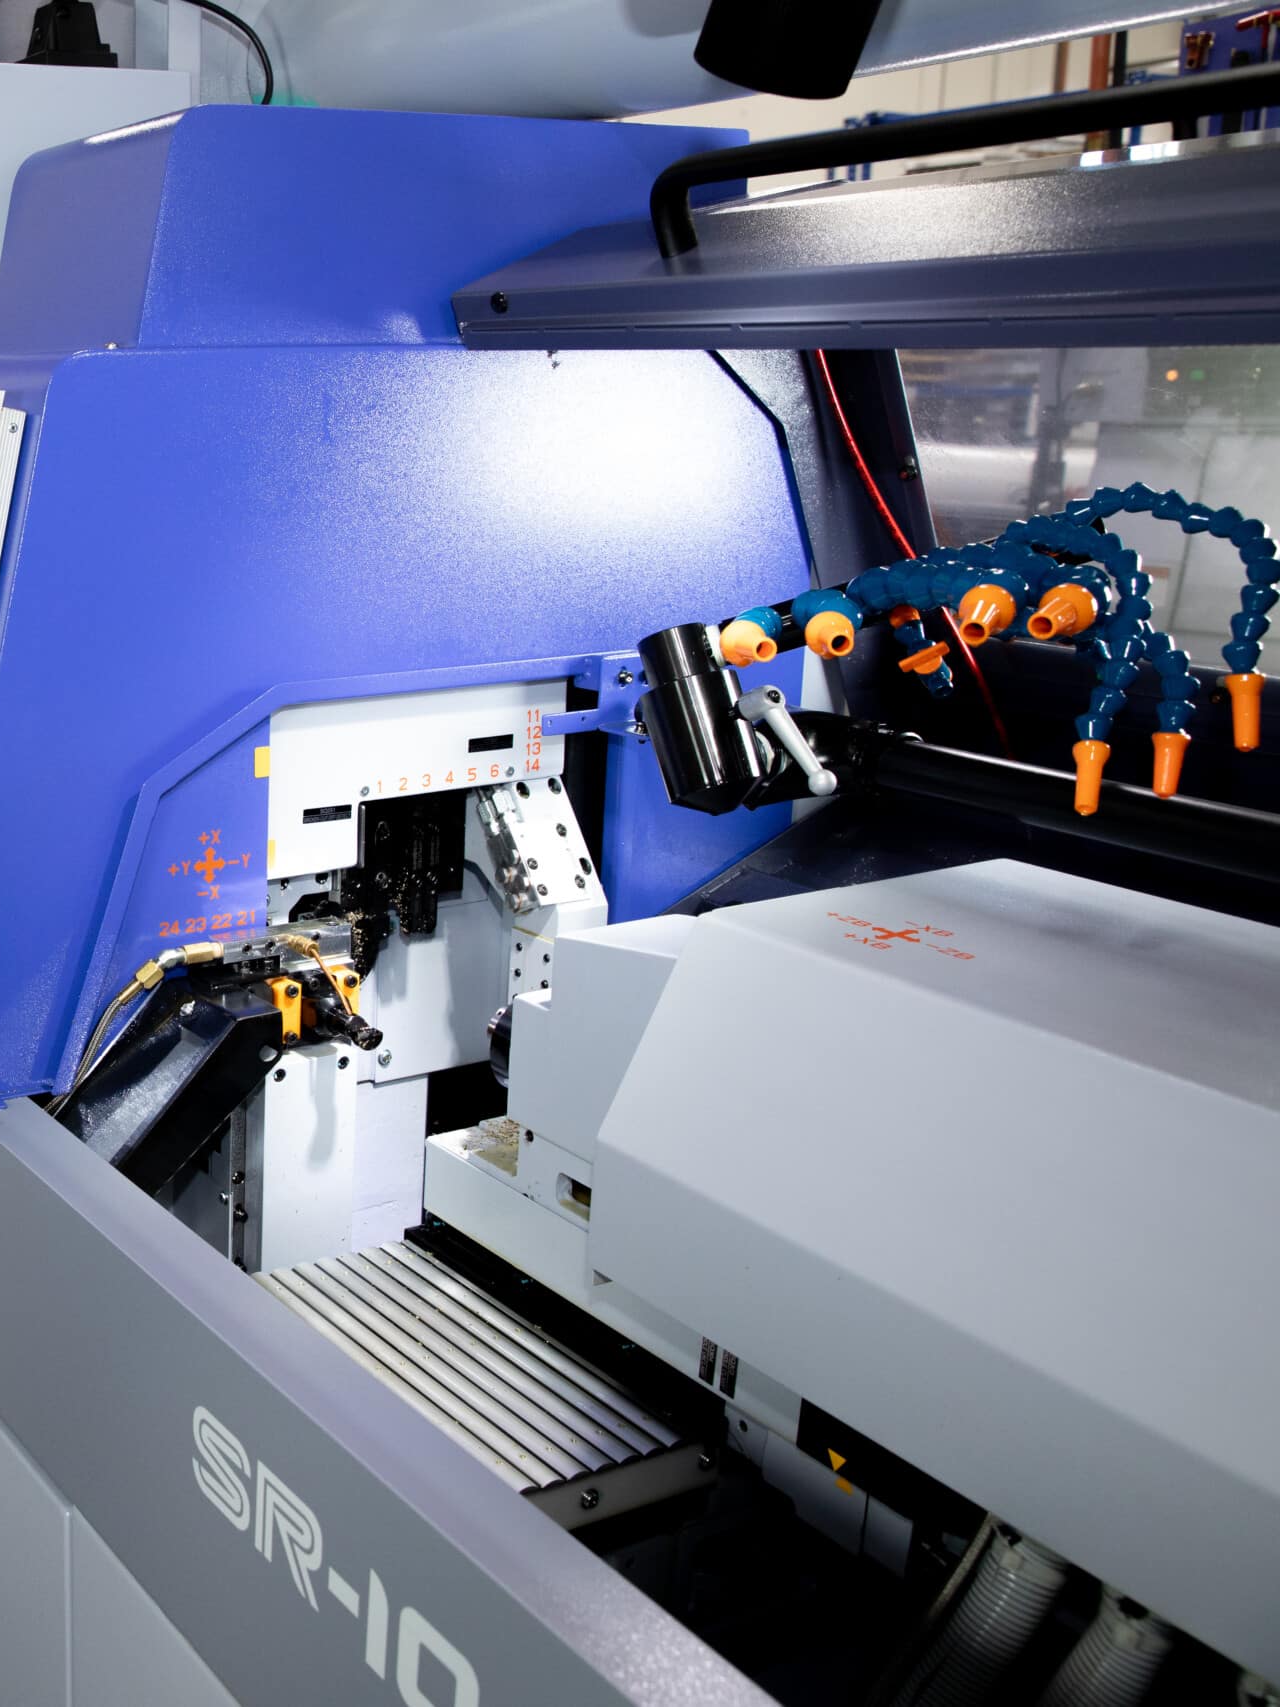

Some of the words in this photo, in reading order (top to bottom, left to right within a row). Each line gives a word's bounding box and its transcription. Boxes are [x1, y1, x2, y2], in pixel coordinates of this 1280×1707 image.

[527, 709, 540, 722] 11
[526, 726, 542, 739] 12
[526, 743, 541, 756] 13
[526, 759, 540, 773] 14
[377, 780, 382, 793] 1
[399, 777, 408, 791] 2
[422, 774, 431, 787] 3
[445, 771, 454, 784] 4
[468, 768, 477, 781] 5
[490, 764, 499, 777] 6
[160, 921, 180, 937] 24
[185, 917, 206, 933] 23
[211, 913, 232, 929] 22
[237, 910, 255, 926] 21
[192, 1405, 480, 1707] SR-10
